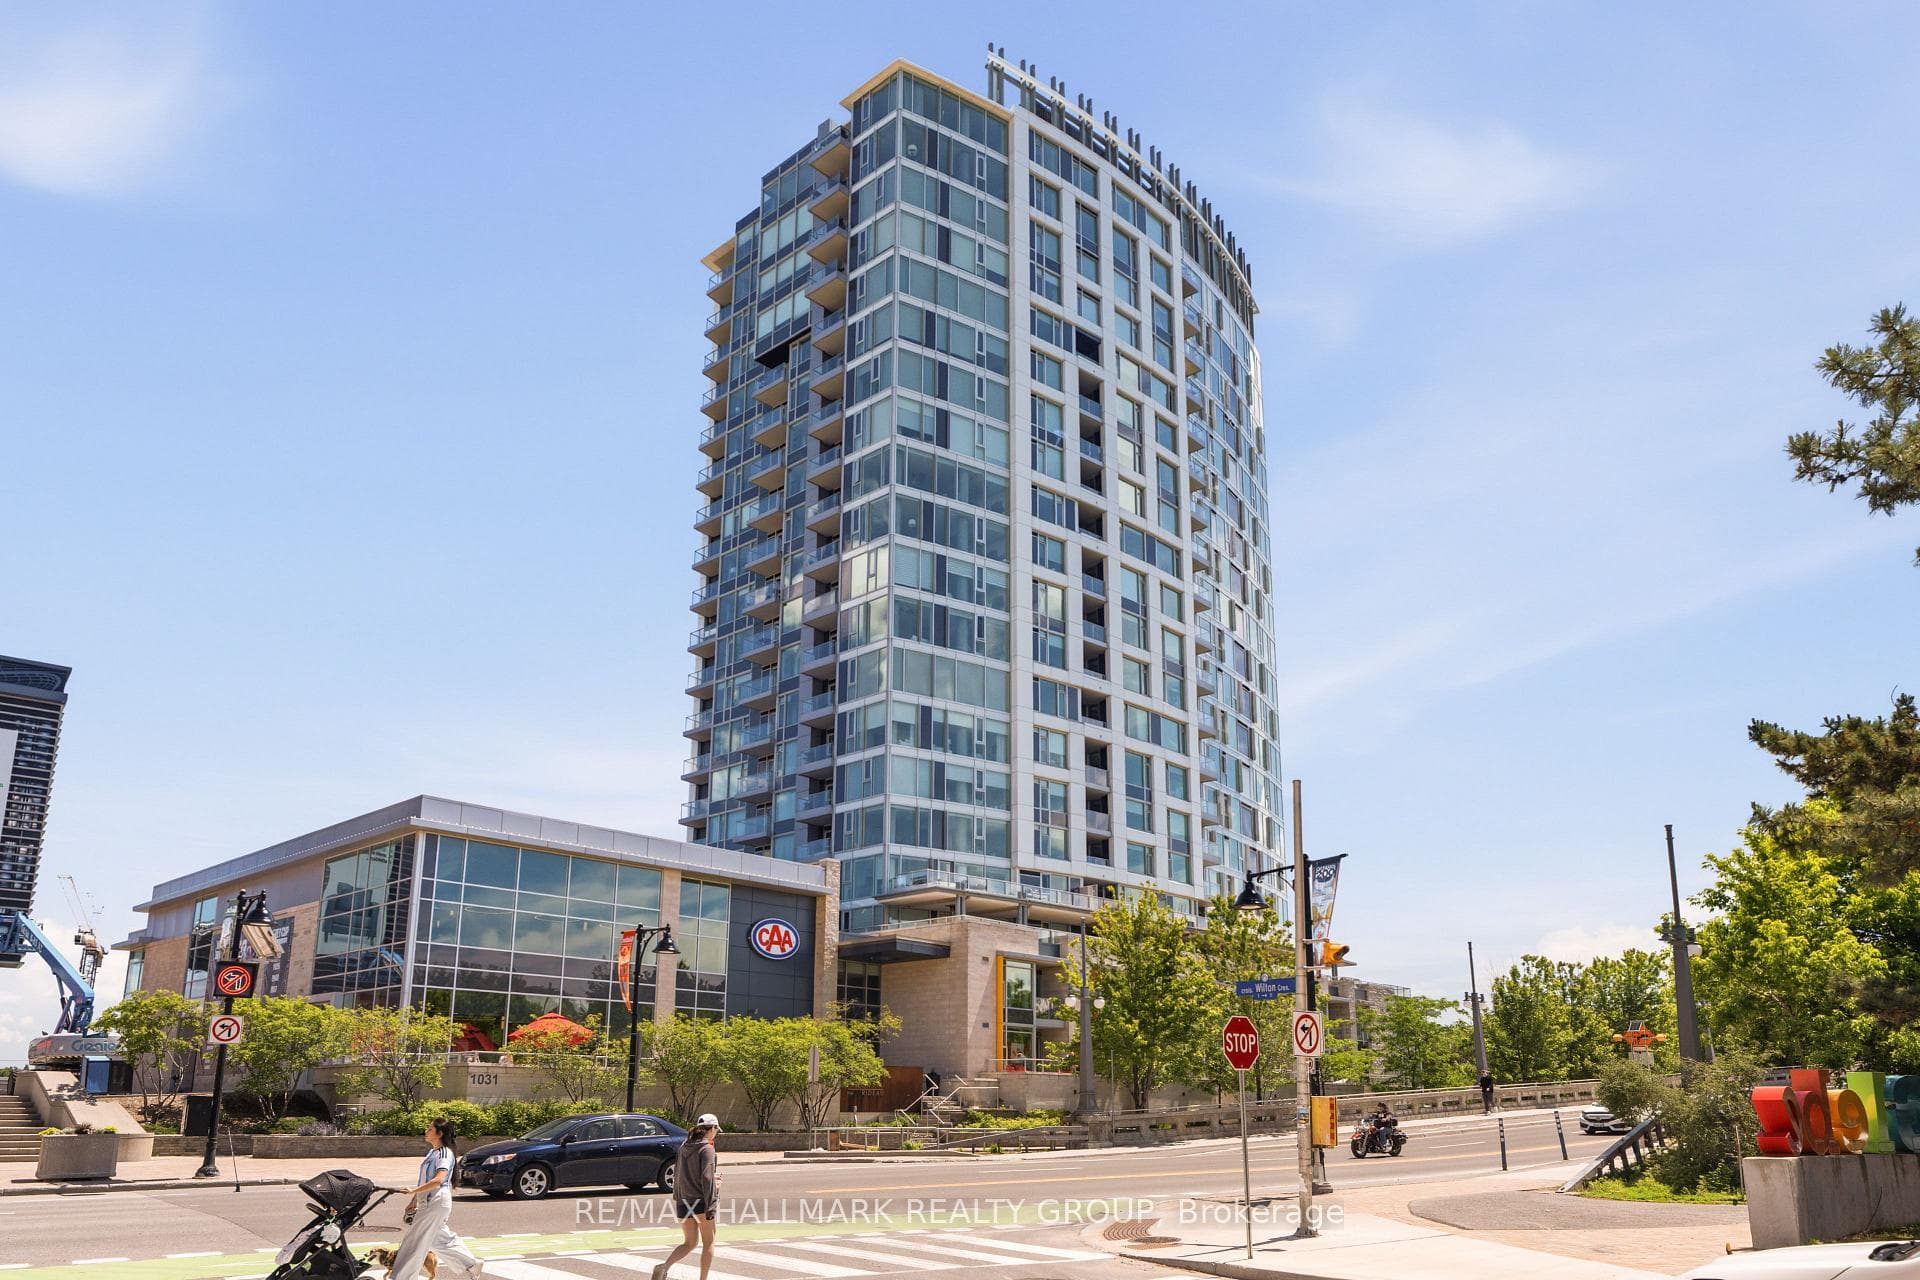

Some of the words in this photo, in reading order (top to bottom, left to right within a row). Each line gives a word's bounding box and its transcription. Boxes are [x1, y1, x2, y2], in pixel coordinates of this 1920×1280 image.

[758, 925, 793, 953] CAA
[1255, 983, 1276, 993] Wilton
[71, 1040, 116, 1052] Genie
[1225, 1033, 1256, 1053] STOP
[470, 1073, 498, 1086] 1031
